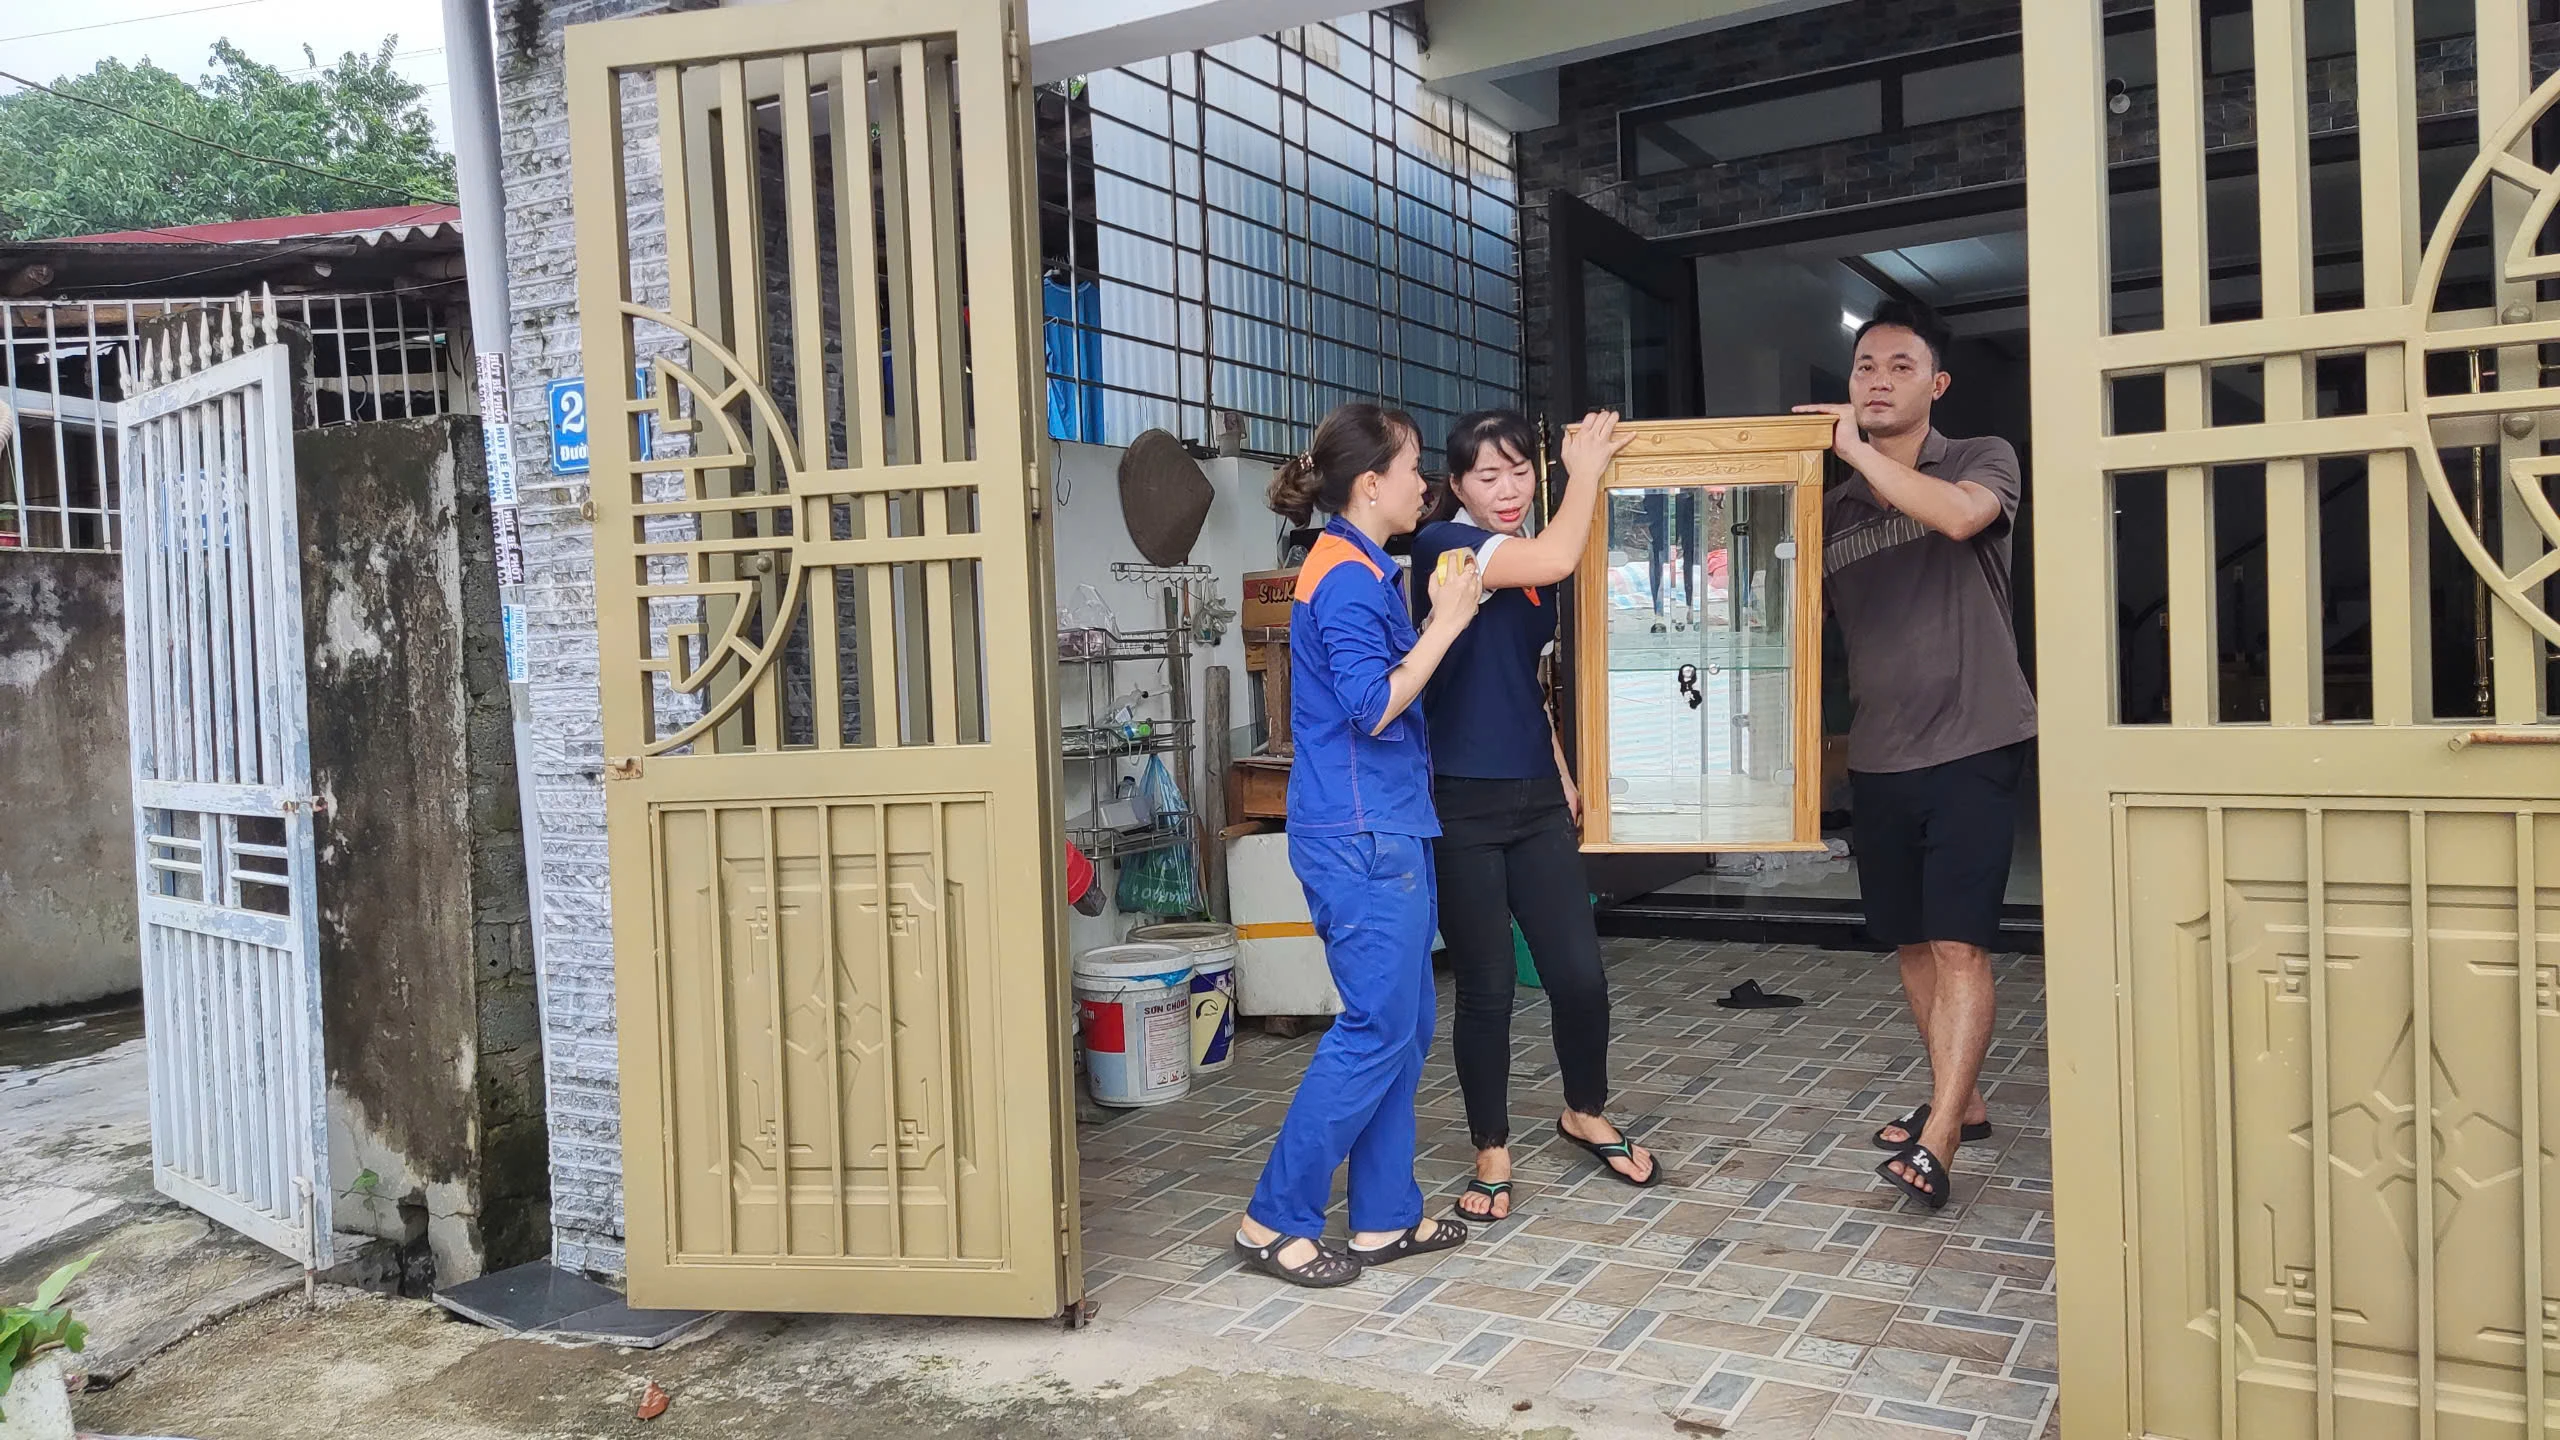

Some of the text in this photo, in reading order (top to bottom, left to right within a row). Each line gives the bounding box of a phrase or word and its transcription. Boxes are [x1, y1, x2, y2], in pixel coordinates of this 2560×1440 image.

[560, 390, 585, 434] 2
[503, 510, 517, 533] HÚT
[1912, 1149, 1933, 1174] LA
